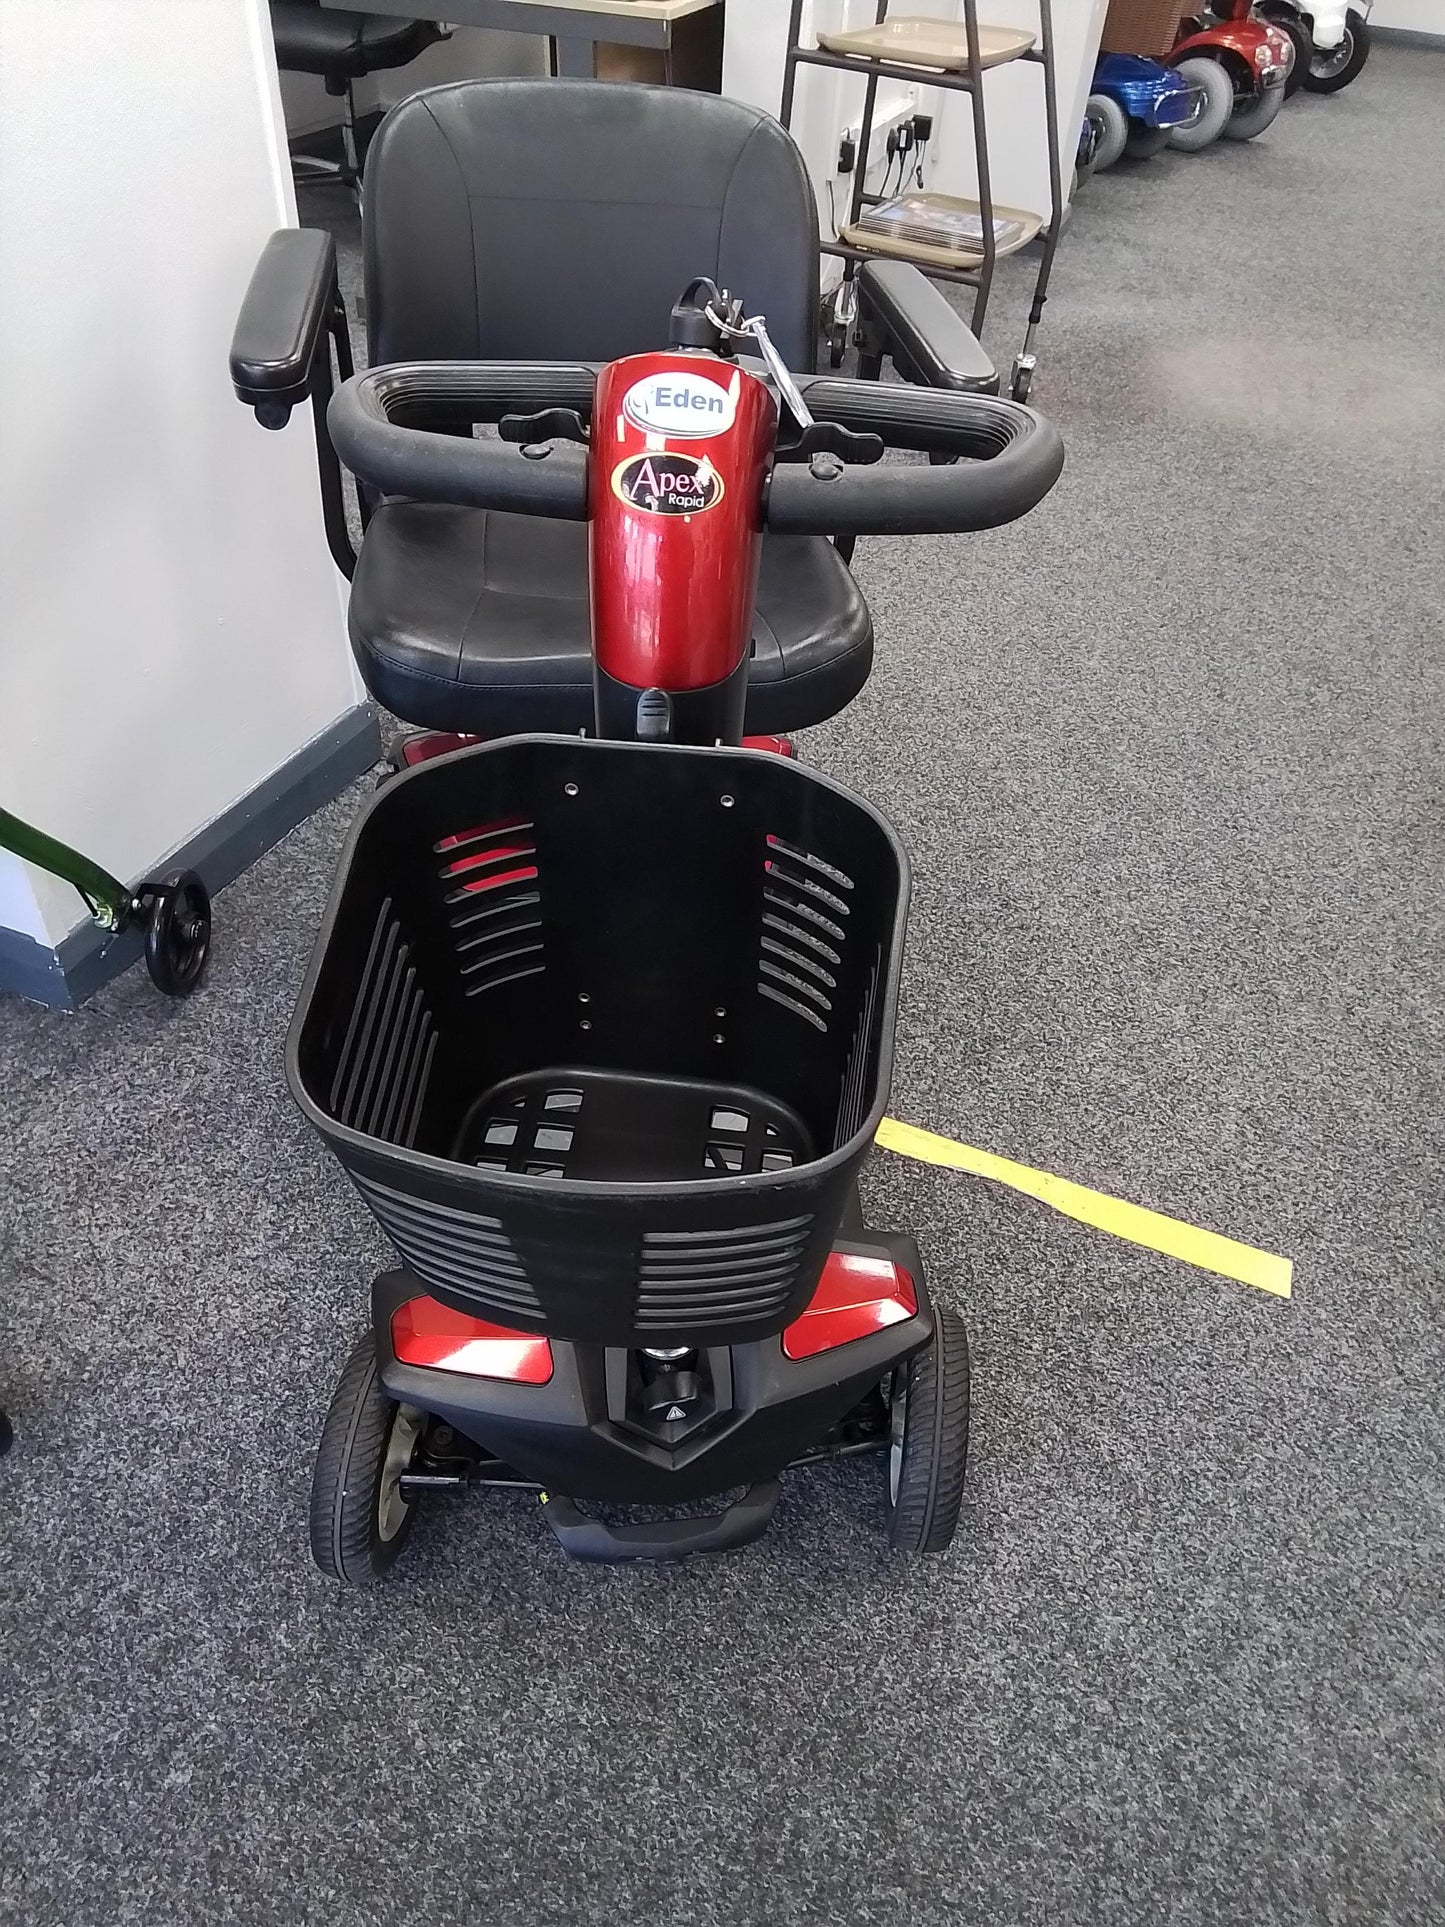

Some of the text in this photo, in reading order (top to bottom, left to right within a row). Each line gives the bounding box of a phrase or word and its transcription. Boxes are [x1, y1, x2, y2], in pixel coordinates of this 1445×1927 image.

[655, 387, 723, 413] Eden
[630, 458, 704, 500] Apex
[668, 492, 705, 508] Rapid
